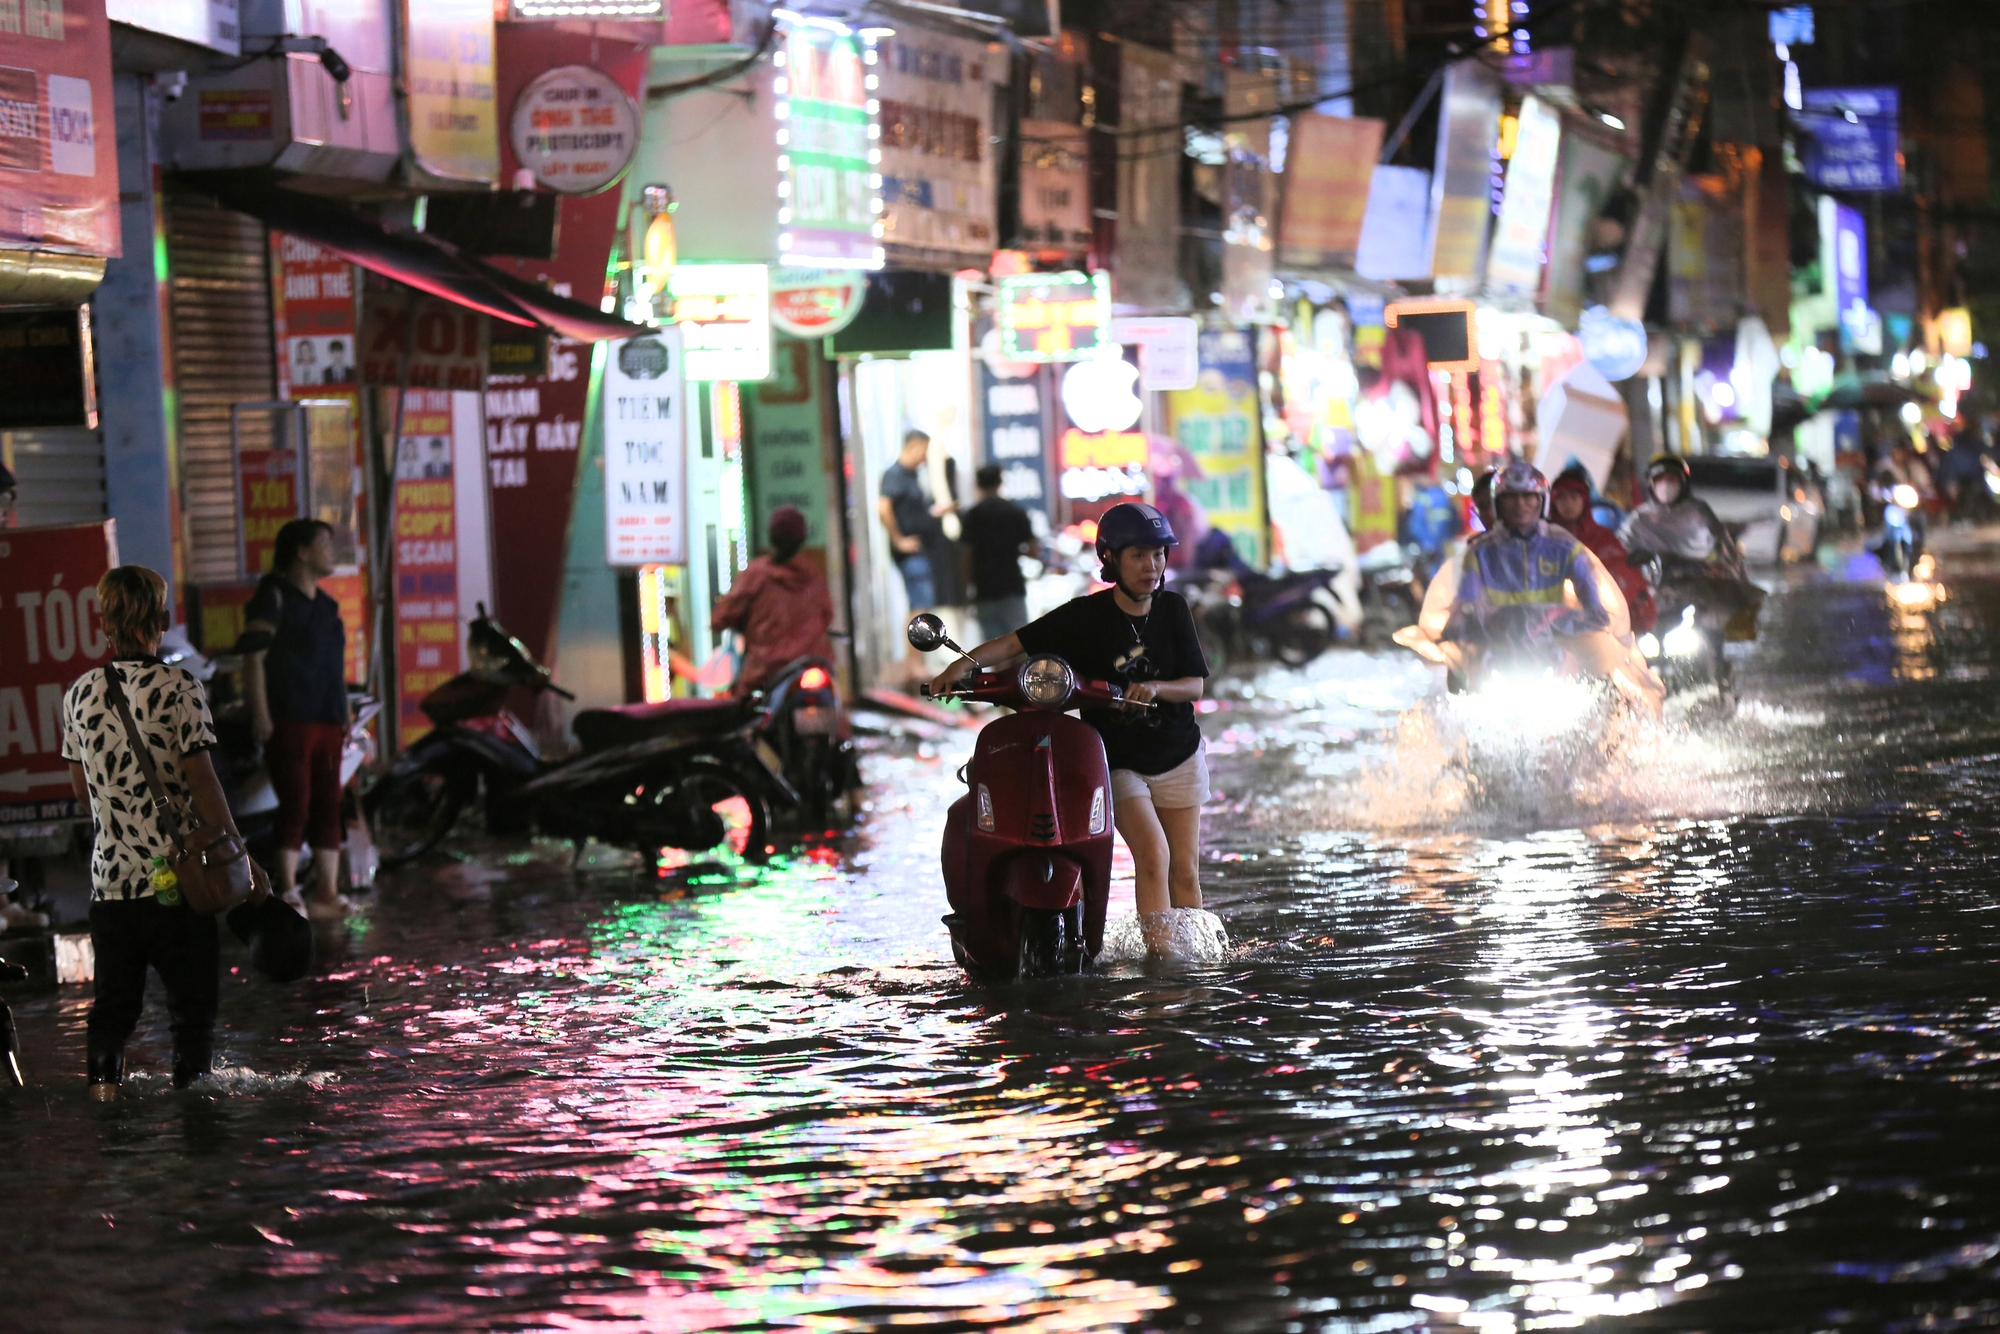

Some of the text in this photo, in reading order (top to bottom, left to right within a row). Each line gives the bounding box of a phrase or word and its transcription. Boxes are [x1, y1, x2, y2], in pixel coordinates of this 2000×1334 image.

[485, 387, 541, 418] NAM
[487, 415, 530, 453] LẤY
[398, 511, 453, 537] COPY
[398, 539, 454, 567] SCAN
[16, 573, 110, 664] TÓC
